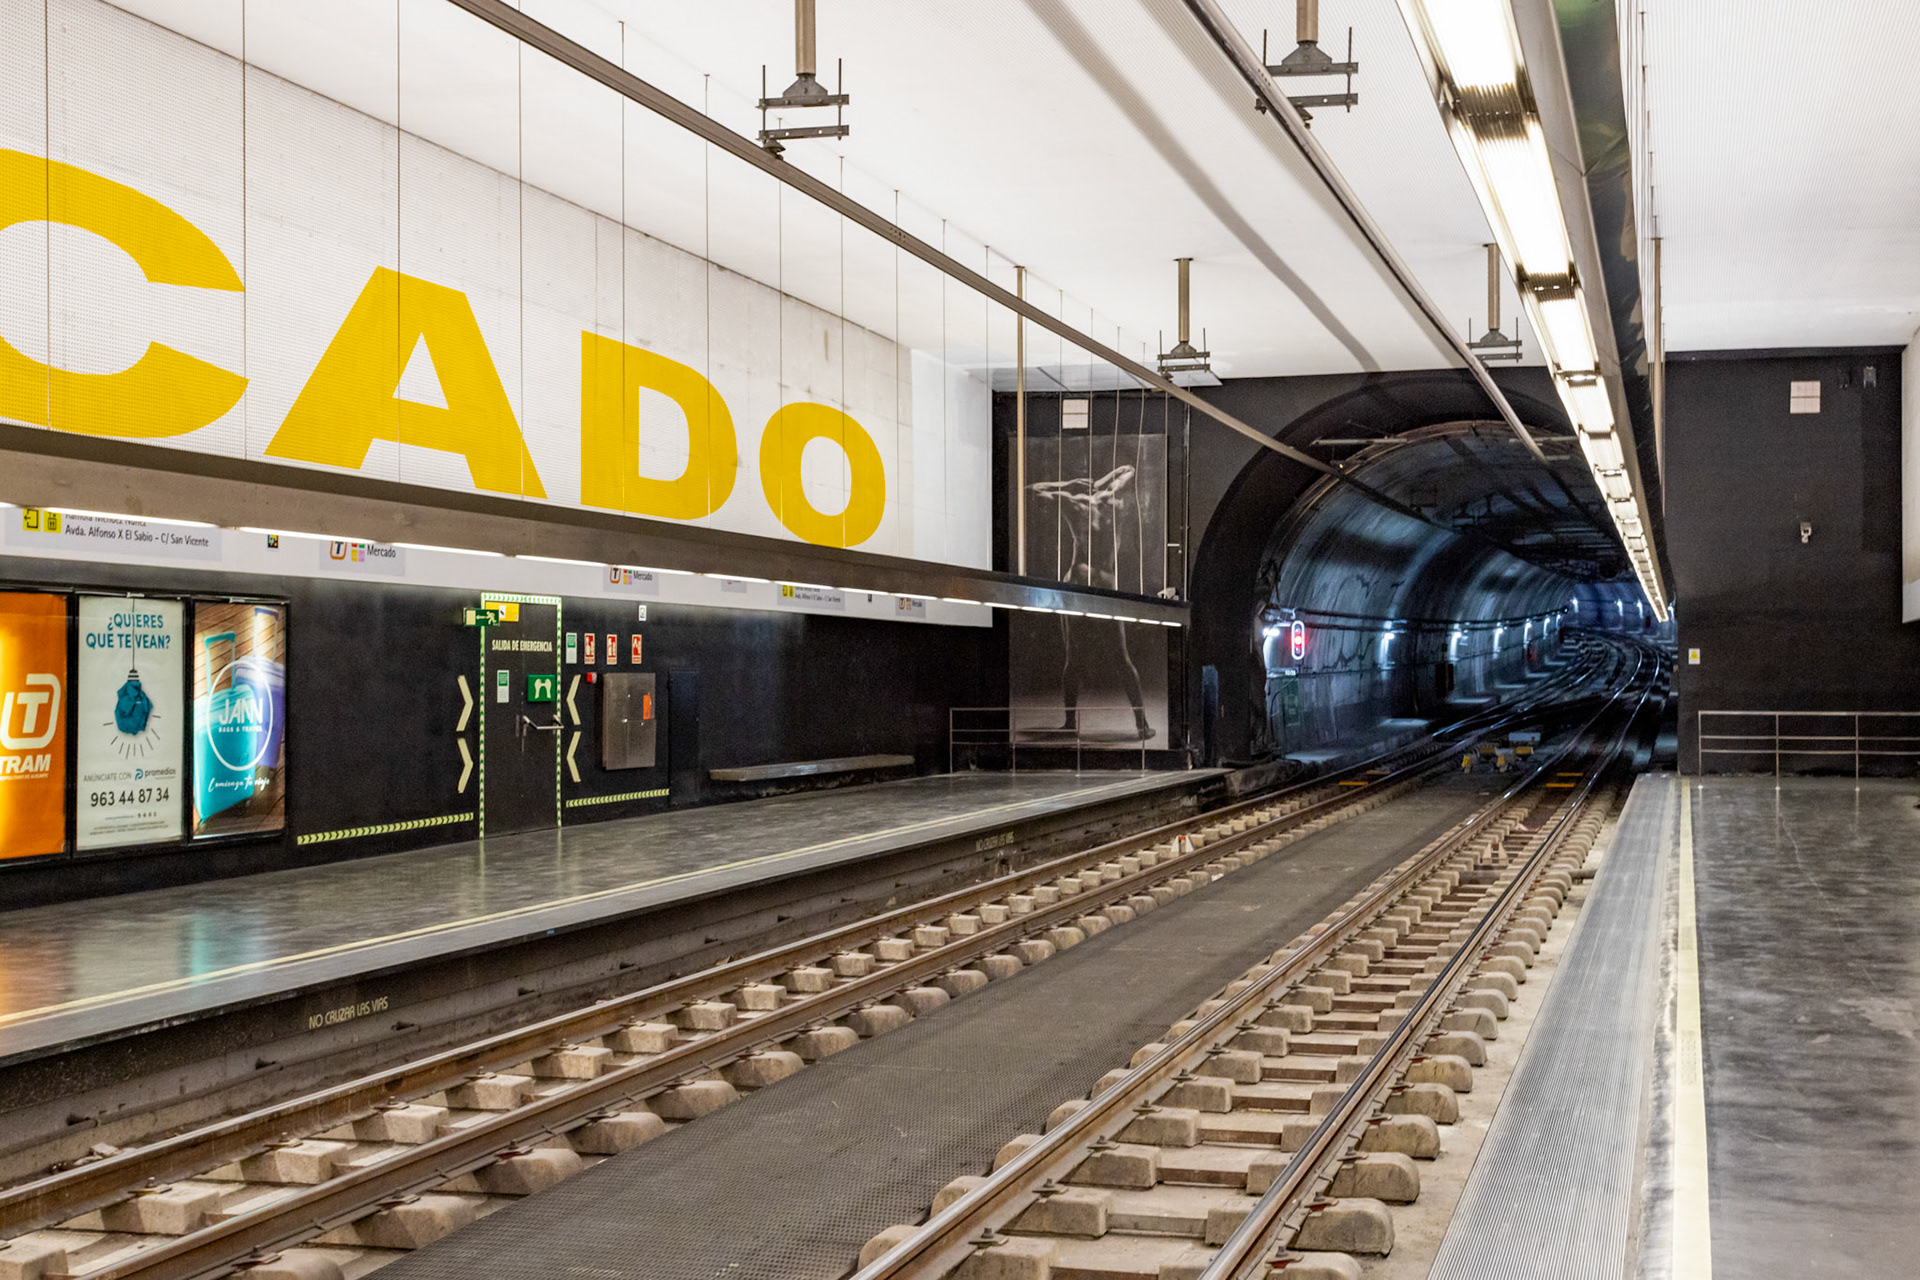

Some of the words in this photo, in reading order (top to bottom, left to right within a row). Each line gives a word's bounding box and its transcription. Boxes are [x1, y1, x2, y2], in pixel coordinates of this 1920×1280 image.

[0, 148, 887, 549] CADO
[65, 524, 86, 537] Avda.
[88, 526, 116, 540] Alfonso
[118, 529, 124, 540] X
[125, 529, 132, 541] El
[134, 529, 153, 543] Sabio
[161, 532, 170, 546] C/
[170, 533, 184, 545] San
[185, 534, 209, 547] Vicente
[366, 543, 397, 559] Mercado
[107, 613, 164, 631] ¿QUIERES
[86, 632, 115, 650] QUE
[117, 633, 132, 649] TE
[135, 634, 171, 650] VEAN?
[491, 639, 511, 651] SALIDA
[511, 640, 520, 651] DE
[520, 640, 553, 653] EMERGENCIA
[0, 754, 51, 775] TRAM
[118, 772, 132, 781] CON
[91, 791, 115, 808] 963
[119, 789, 135, 805] 44
[138, 788, 153, 804] 87
[156, 787, 169, 802] 34
[308, 1013, 324, 1029] NO
[325, 1005, 355, 1025] CRUZAR
[356, 1001, 371, 1017] LAS
